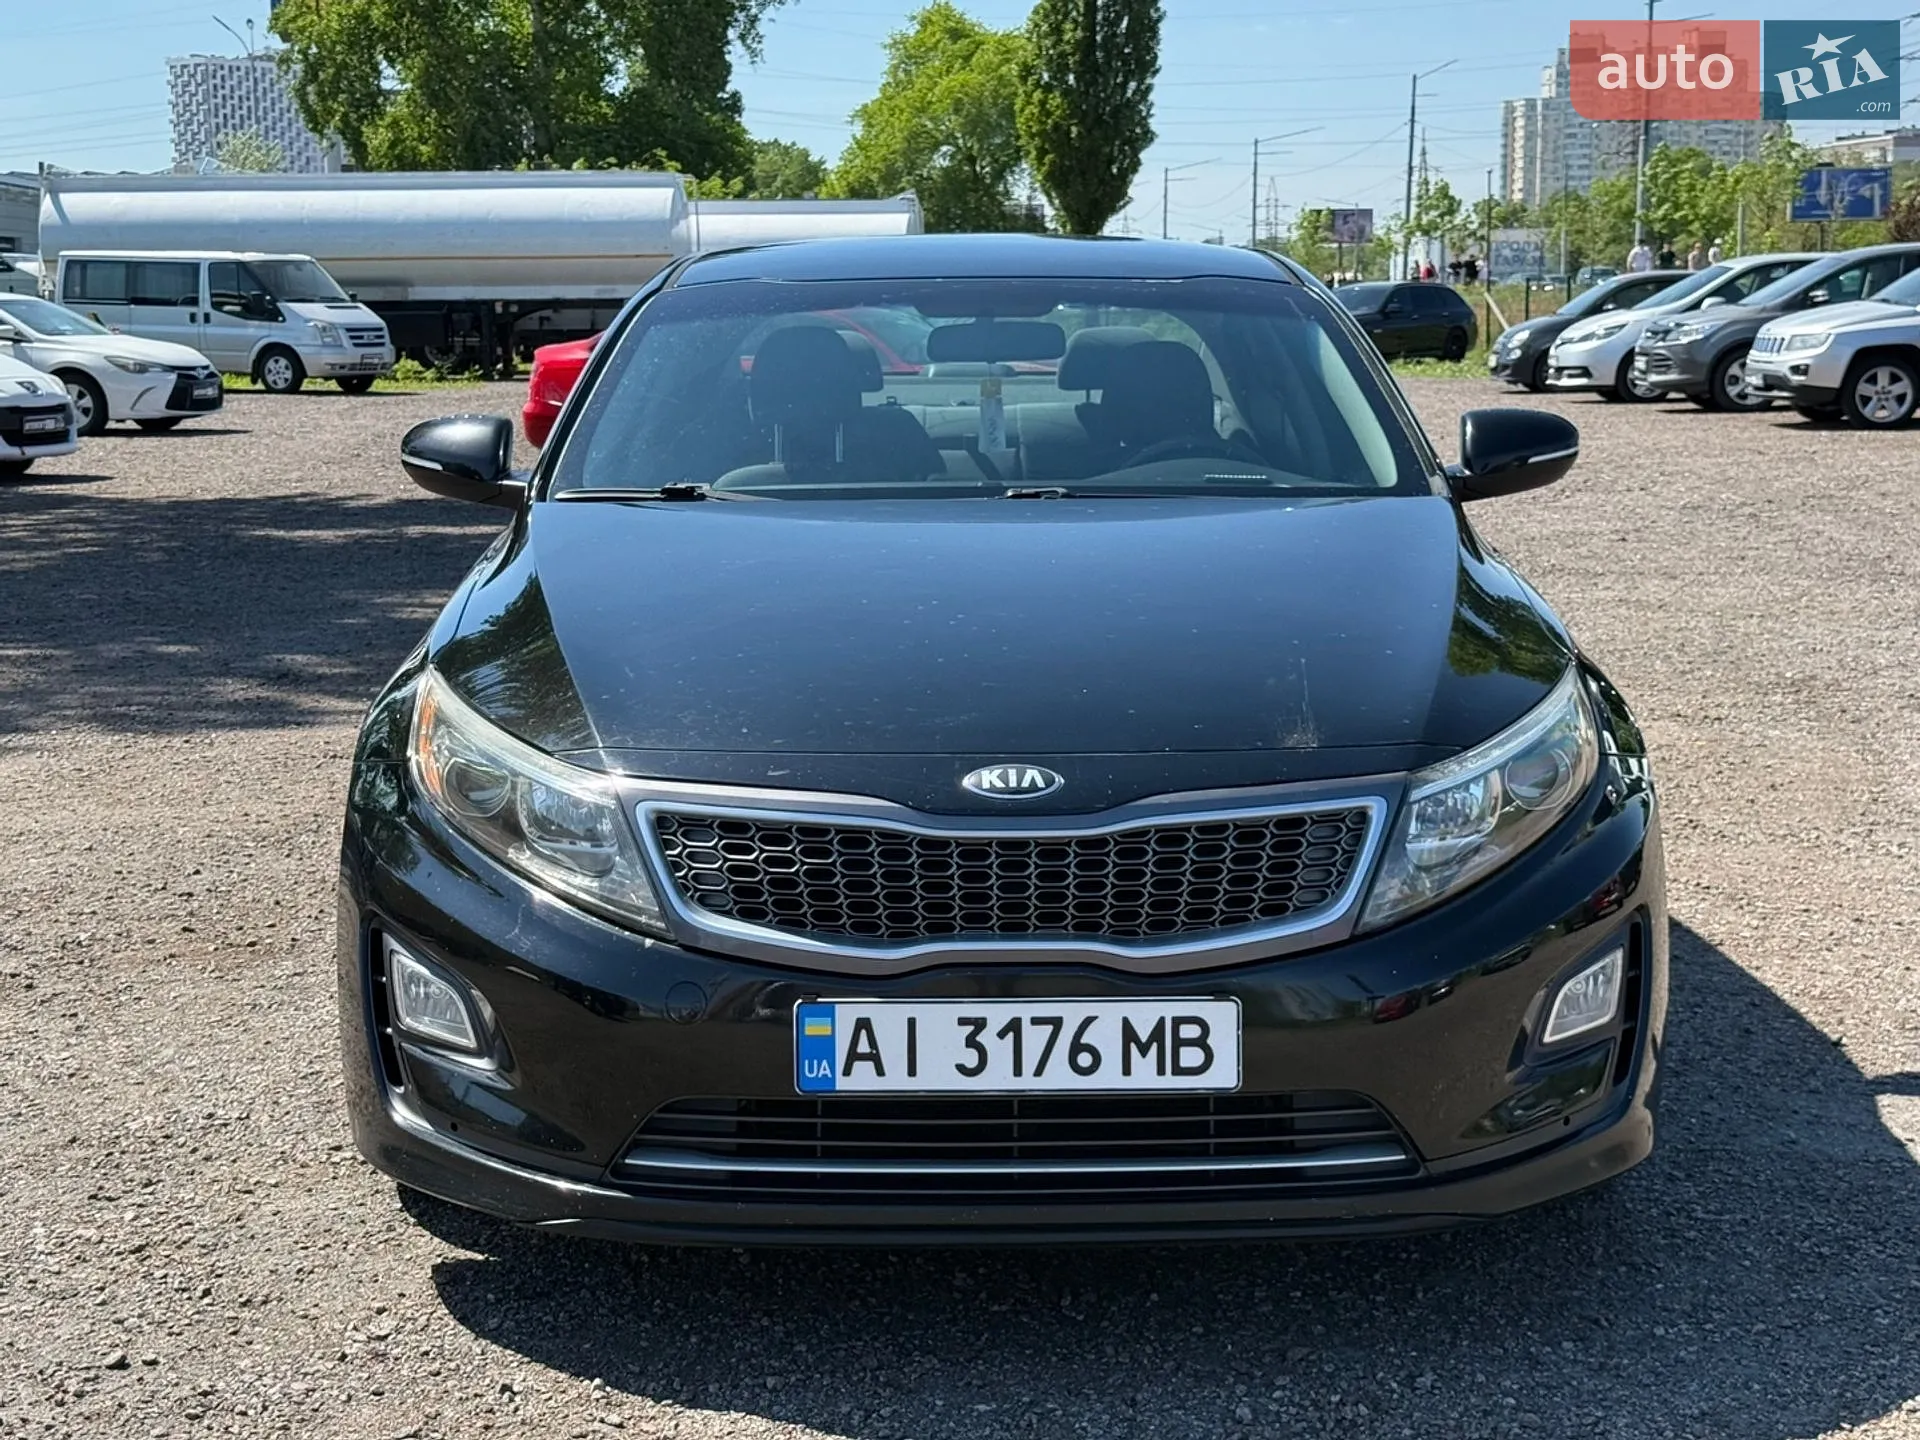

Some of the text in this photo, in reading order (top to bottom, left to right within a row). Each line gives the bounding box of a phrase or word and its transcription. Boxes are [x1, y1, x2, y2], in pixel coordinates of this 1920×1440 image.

[980, 768, 1046, 790] KIA
[842, 1016, 1214, 1077] AI 3176 MB
[804, 1059, 832, 1078] UA
